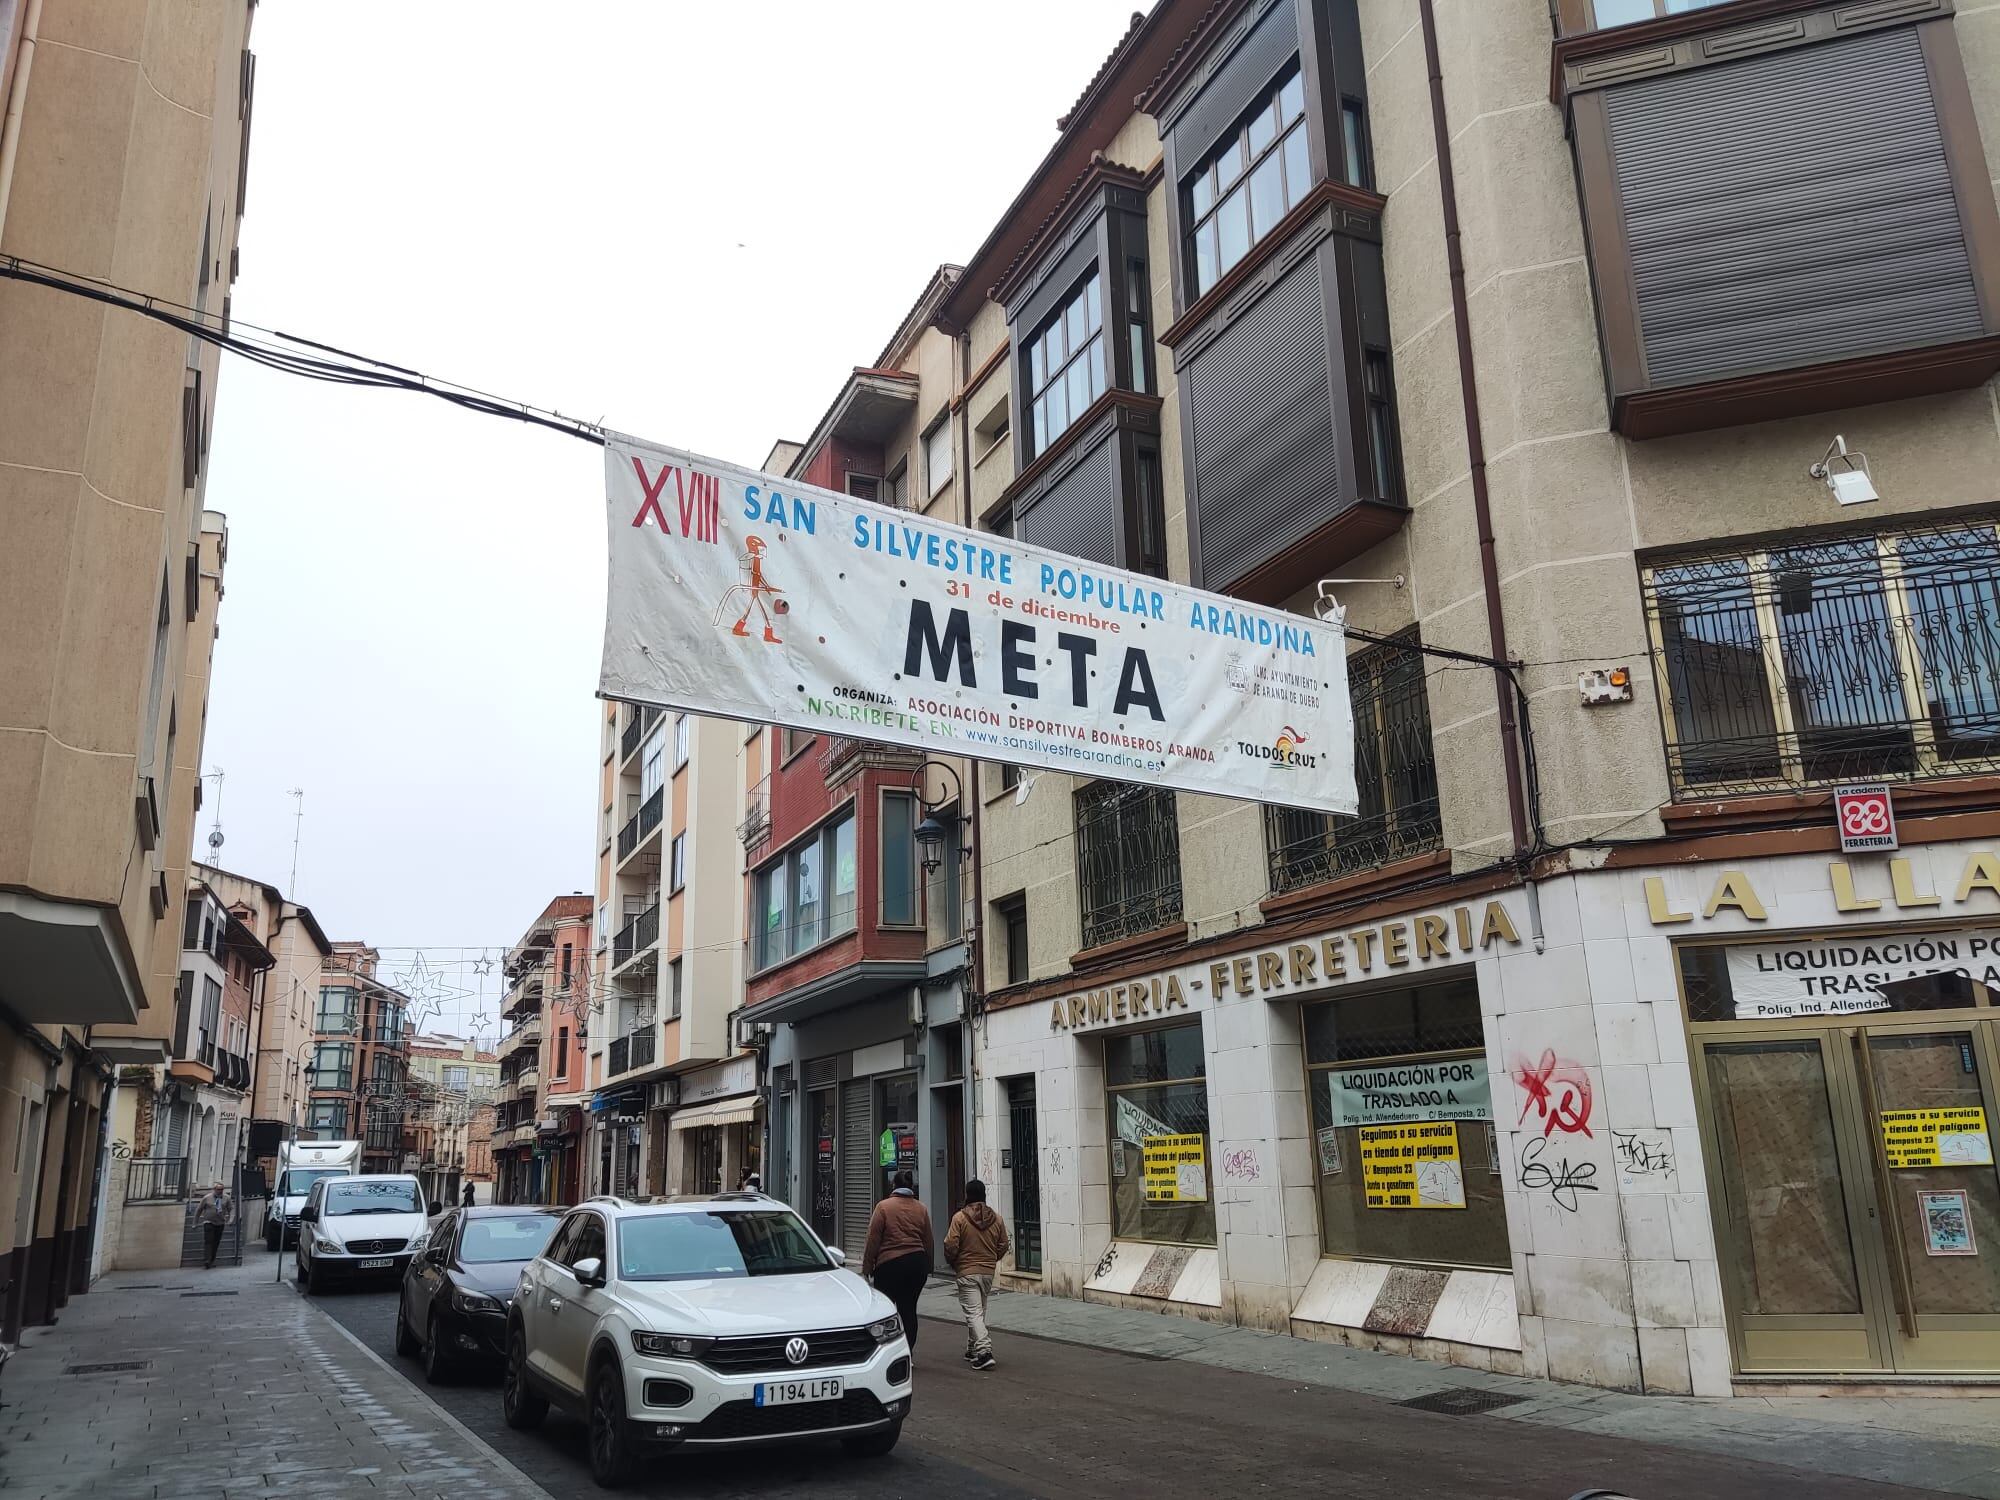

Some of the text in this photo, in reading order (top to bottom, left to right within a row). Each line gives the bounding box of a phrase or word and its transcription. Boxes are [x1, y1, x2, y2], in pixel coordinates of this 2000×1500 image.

[631, 456, 1316, 658] XVIII SAN SILVESTRE POPULAR ARANDINA
[946, 580, 1121, 633] 31 de diciembre
[904, 598, 1167, 722] META
[1253, 665, 1318, 691] ILMO. AYUNTAMIENTO
[1253, 682, 1320, 709] DE ARANDA DE DUERO
[801, 697, 919, 732] NSCRÍBETE
[965, 729, 1161, 772] www.sansilvestrearandina.es
[833, 686, 1216, 764] ORGANIZA: ASOCIACIÓN DEPORTIVA BOMBEROS ARANDA
[1238, 741, 1316, 769] TOLDOS CRUZ
[1850, 787, 1886, 795] cadena
[1844, 836, 1894, 848] FERRETERIA
[1644, 870, 1769, 925] LA
[1756, 938, 1959, 973] LIQUIDACIÓN
[1757, 1004, 1796, 1017] Polig.
[1800, 1002, 1826, 1013] Ind.
[1341, 1064, 1475, 1090] LIQUIDACIÓN POR
[1362, 1089, 1460, 1110] TRASLADO A
[1477, 1108, 1486, 1118] 23
[1943, 1109, 1980, 1119] servicio
[1361, 1129, 1397, 1143] Seguimos
[1407, 1128, 1417, 1138] su
[1420, 1125, 1452, 1137] servicio
[1889, 1125, 1919, 1133] tienda
[1922, 1123, 1936, 1132] del
[1939, 1123, 1980, 1133] polígono
[1363, 1144, 1454, 1159] en tienda del polígono
[1373, 1165, 1402, 1176] Bemposta
[1404, 1164, 1413, 1174] 23
[769, 1380, 839, 1402] 1194 LFD
